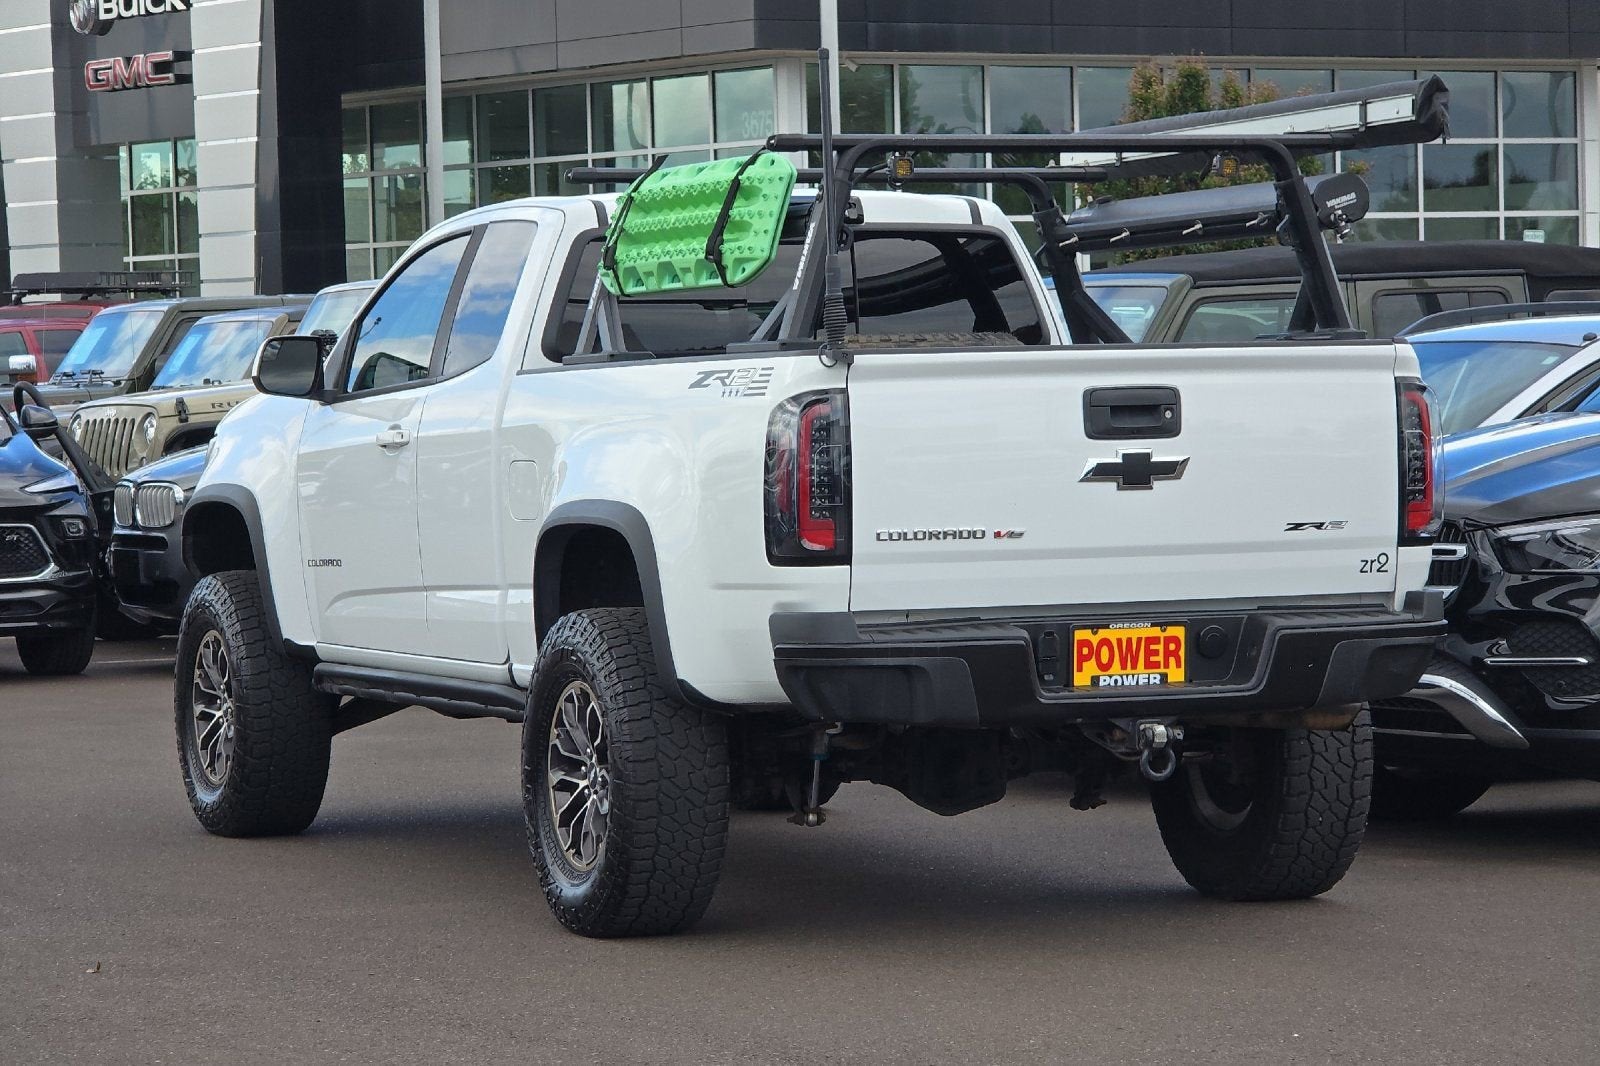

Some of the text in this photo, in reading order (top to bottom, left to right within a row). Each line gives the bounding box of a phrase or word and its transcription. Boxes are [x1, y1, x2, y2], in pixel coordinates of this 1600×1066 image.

[85, 50, 175, 91] GMC
[742, 110, 774, 139] 3675
[1284, 520, 1348, 531] ZR2
[876, 528, 986, 541] COLORADO
[307, 559, 342, 567] COLORADO
[1360, 552, 1389, 573] zr2
[1076, 635, 1182, 673] POWER
[1099, 673, 1161, 687] POWER
